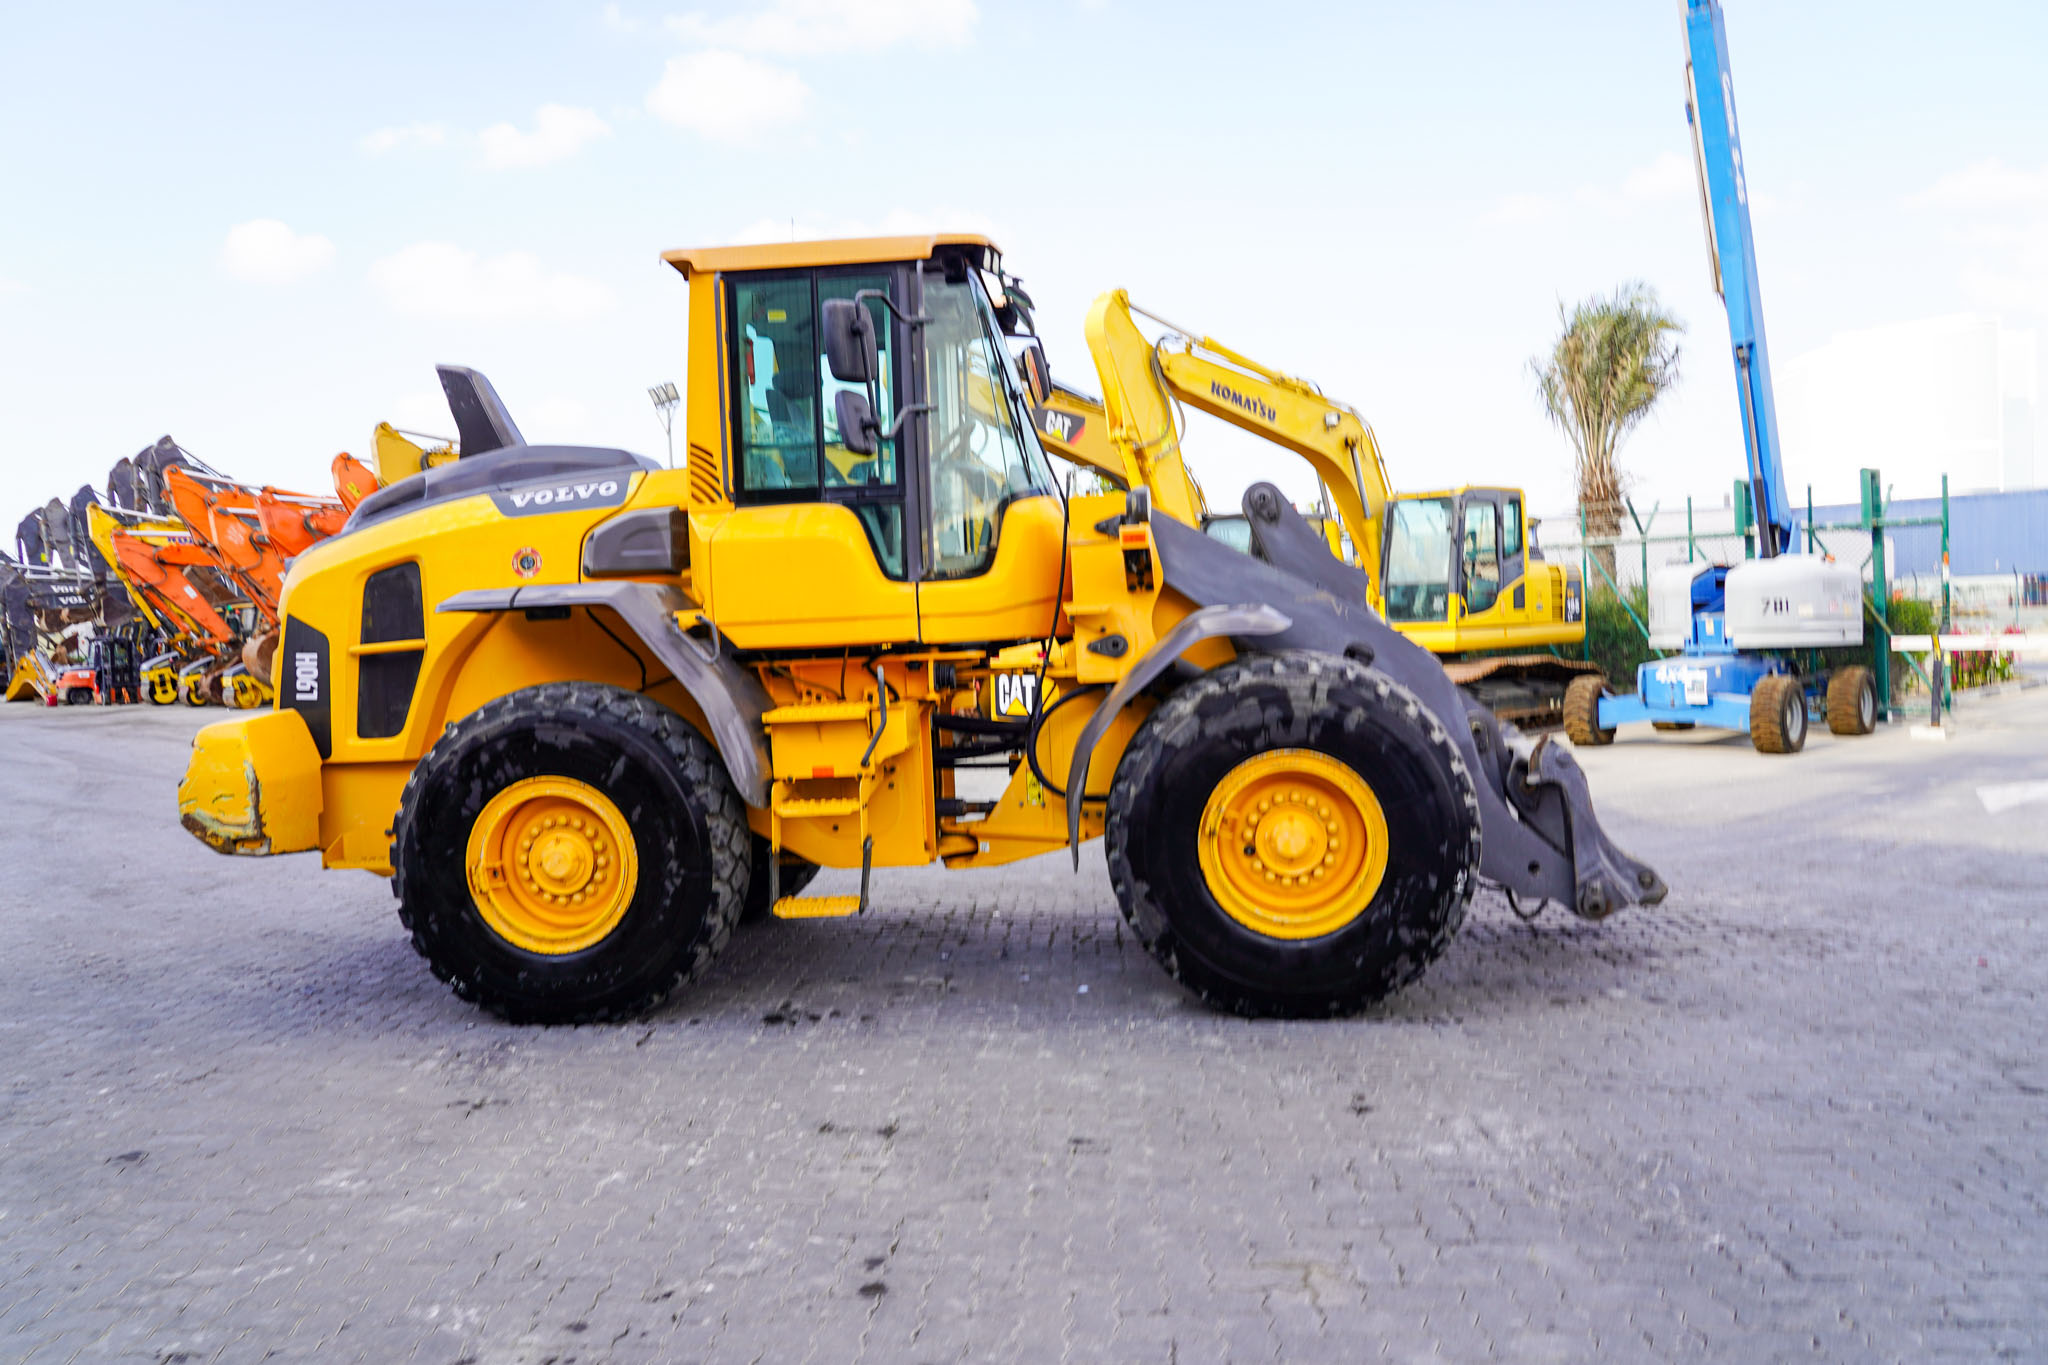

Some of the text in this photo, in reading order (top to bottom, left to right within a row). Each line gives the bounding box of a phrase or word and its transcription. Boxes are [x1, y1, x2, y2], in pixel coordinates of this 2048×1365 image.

[1210, 380, 1277, 422] KOMATSU
[1045, 410, 1072, 442] CAT
[509, 480, 618, 508] VOLVO
[295, 652, 319, 702] L90H
[998, 673, 1036, 716] CAT
